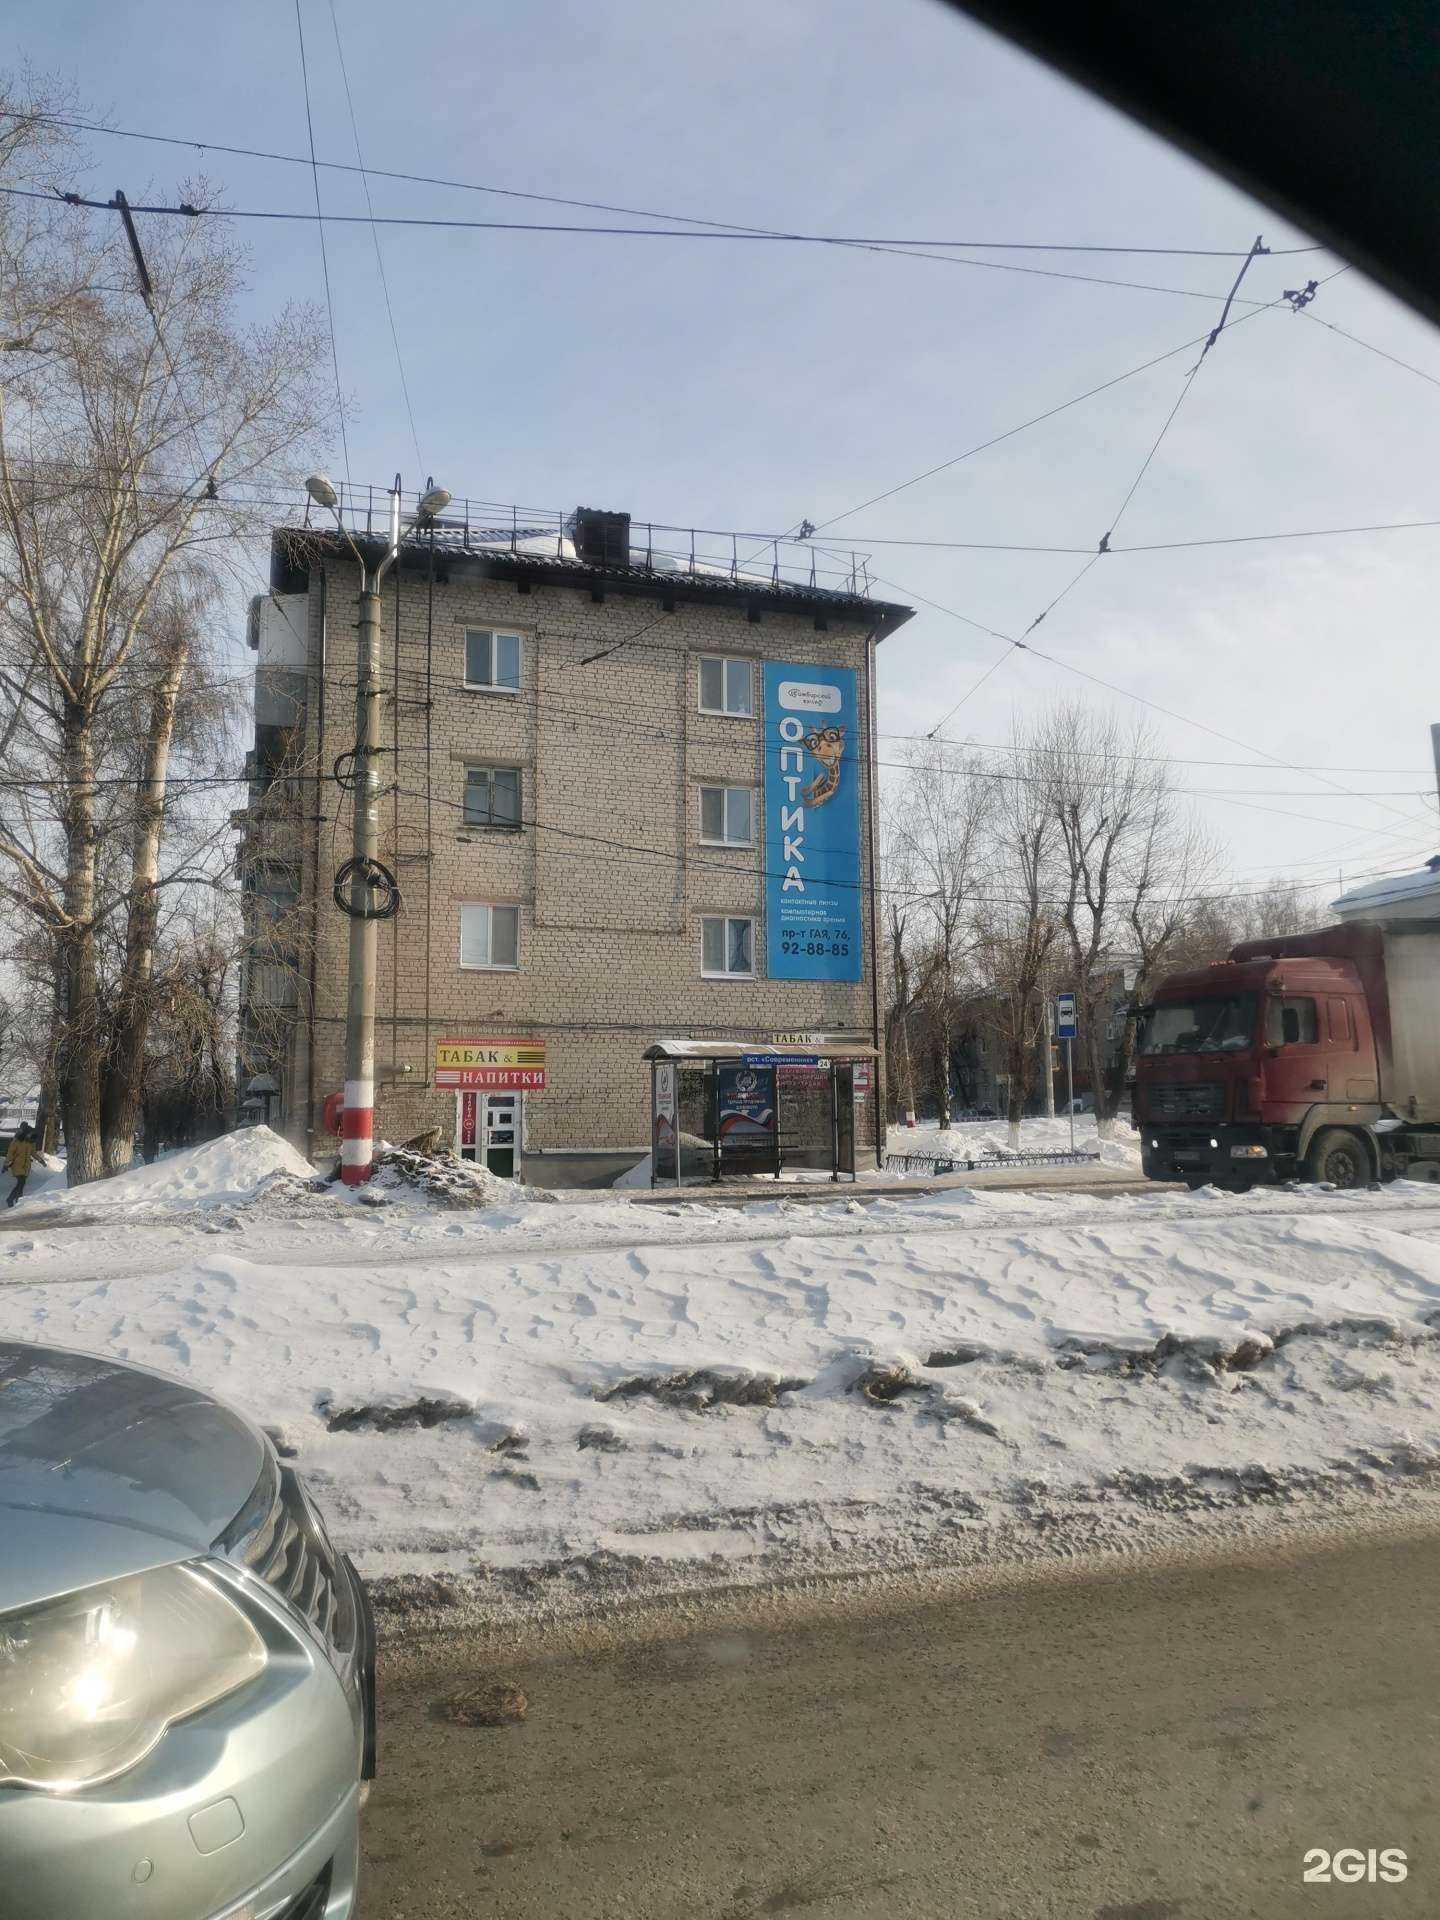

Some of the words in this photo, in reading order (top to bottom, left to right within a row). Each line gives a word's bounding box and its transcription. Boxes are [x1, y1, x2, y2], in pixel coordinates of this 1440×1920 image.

[779, 717, 805, 892] ОПТИКА
[780, 915, 822, 923] диагностика
[782, 929, 807, 940] пр-т
[834, 930, 851, 941] 76,
[781, 942, 849, 956] 92-88-85
[774, 1034, 812, 1043] ТАБАК
[440, 1050, 499, 1063] ТАБАК
[503, 1054, 514, 1063] &
[819, 1060, 828, 1068] 24
[463, 1071, 545, 1084] НАПИТКИ
